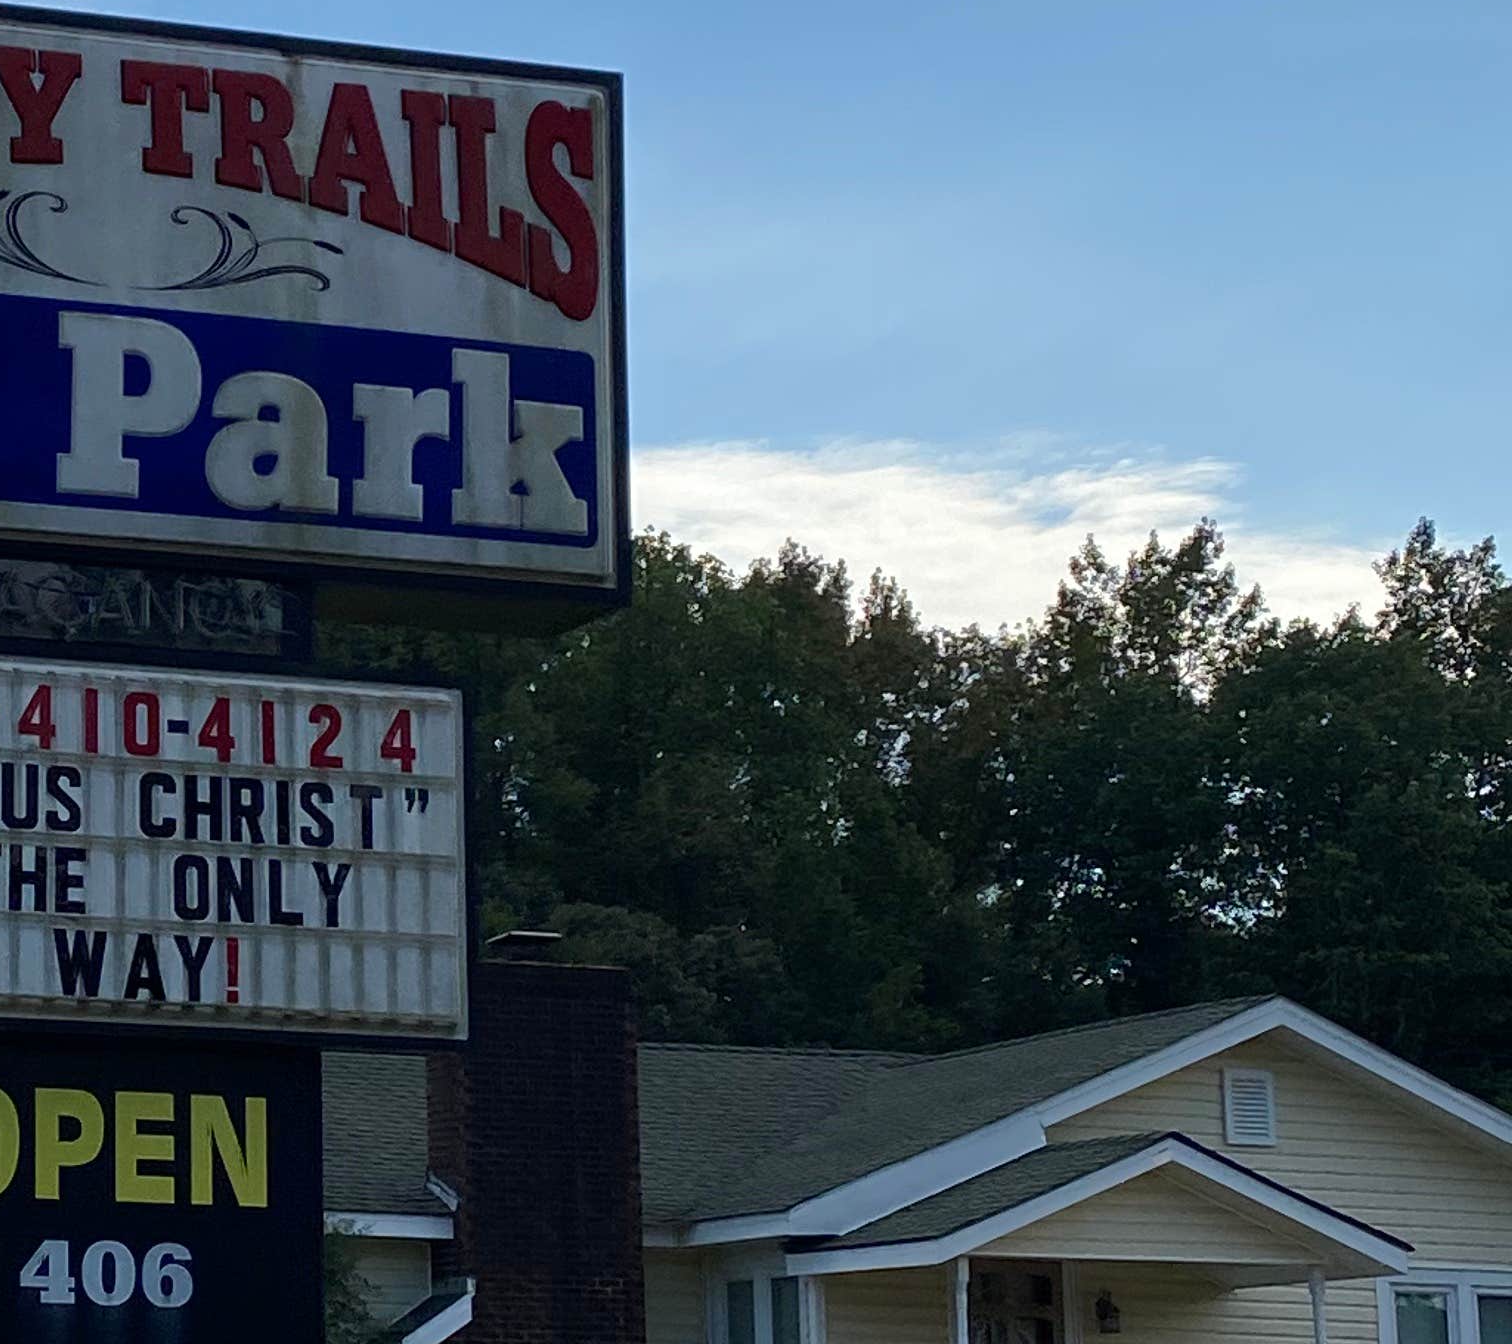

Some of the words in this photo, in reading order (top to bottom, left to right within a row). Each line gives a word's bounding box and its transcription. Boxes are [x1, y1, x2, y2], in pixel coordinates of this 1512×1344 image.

[121, 59, 598, 321] TRAILS
[55, 312, 589, 536] Park
[174, 855, 352, 928] ONLY
[53, 928, 240, 1004] WAY!
[19, 1239, 194, 1308] 406
